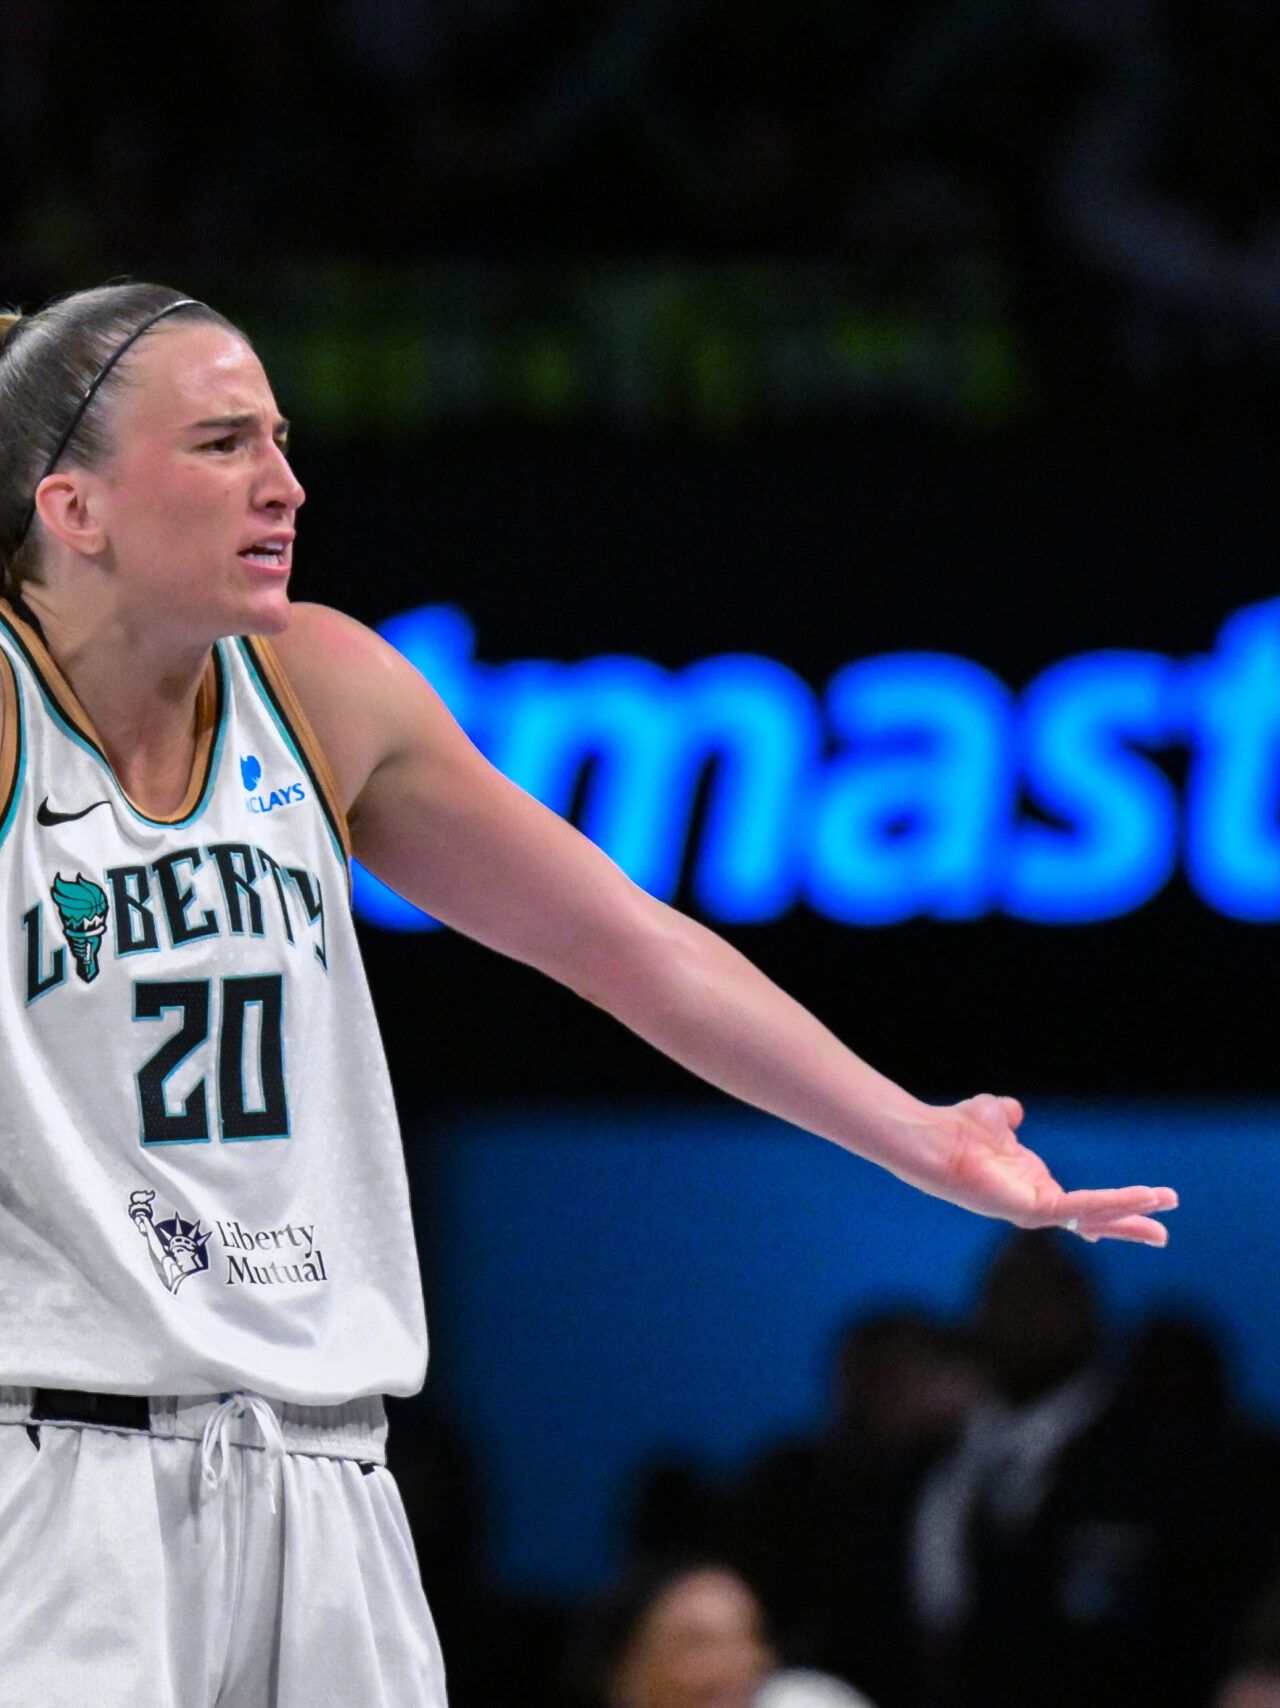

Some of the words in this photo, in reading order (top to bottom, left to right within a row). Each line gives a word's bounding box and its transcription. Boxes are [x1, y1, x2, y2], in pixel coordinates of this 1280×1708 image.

[132, 974, 292, 1146] 20
[216, 1219, 316, 1259] Liberty
[224, 1250, 328, 1286] Mutual
